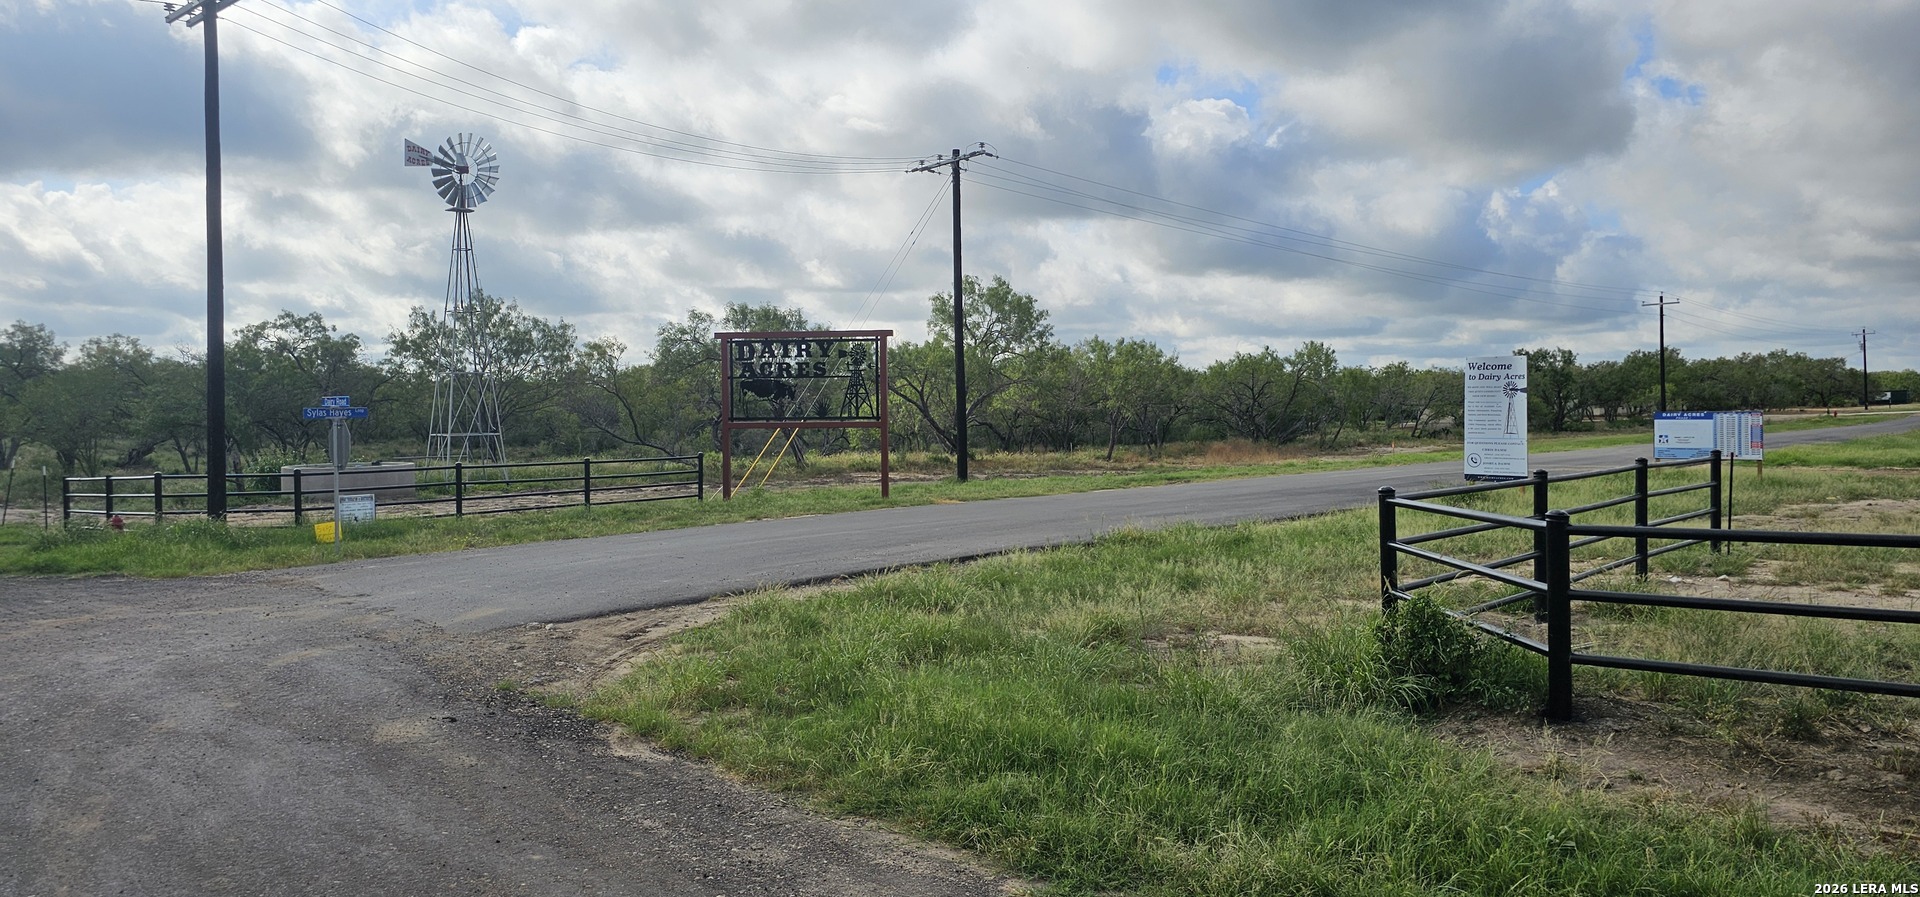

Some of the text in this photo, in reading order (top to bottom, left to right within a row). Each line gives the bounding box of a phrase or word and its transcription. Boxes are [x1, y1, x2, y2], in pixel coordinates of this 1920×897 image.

[735, 341, 836, 361] DAIRY
[739, 362, 827, 378] ACRES
[1468, 362, 1513, 371] Welcome
[1478, 373, 1502, 382] Dairy
[306, 408, 327, 418] Sylas
[330, 409, 352, 417] Hayes
